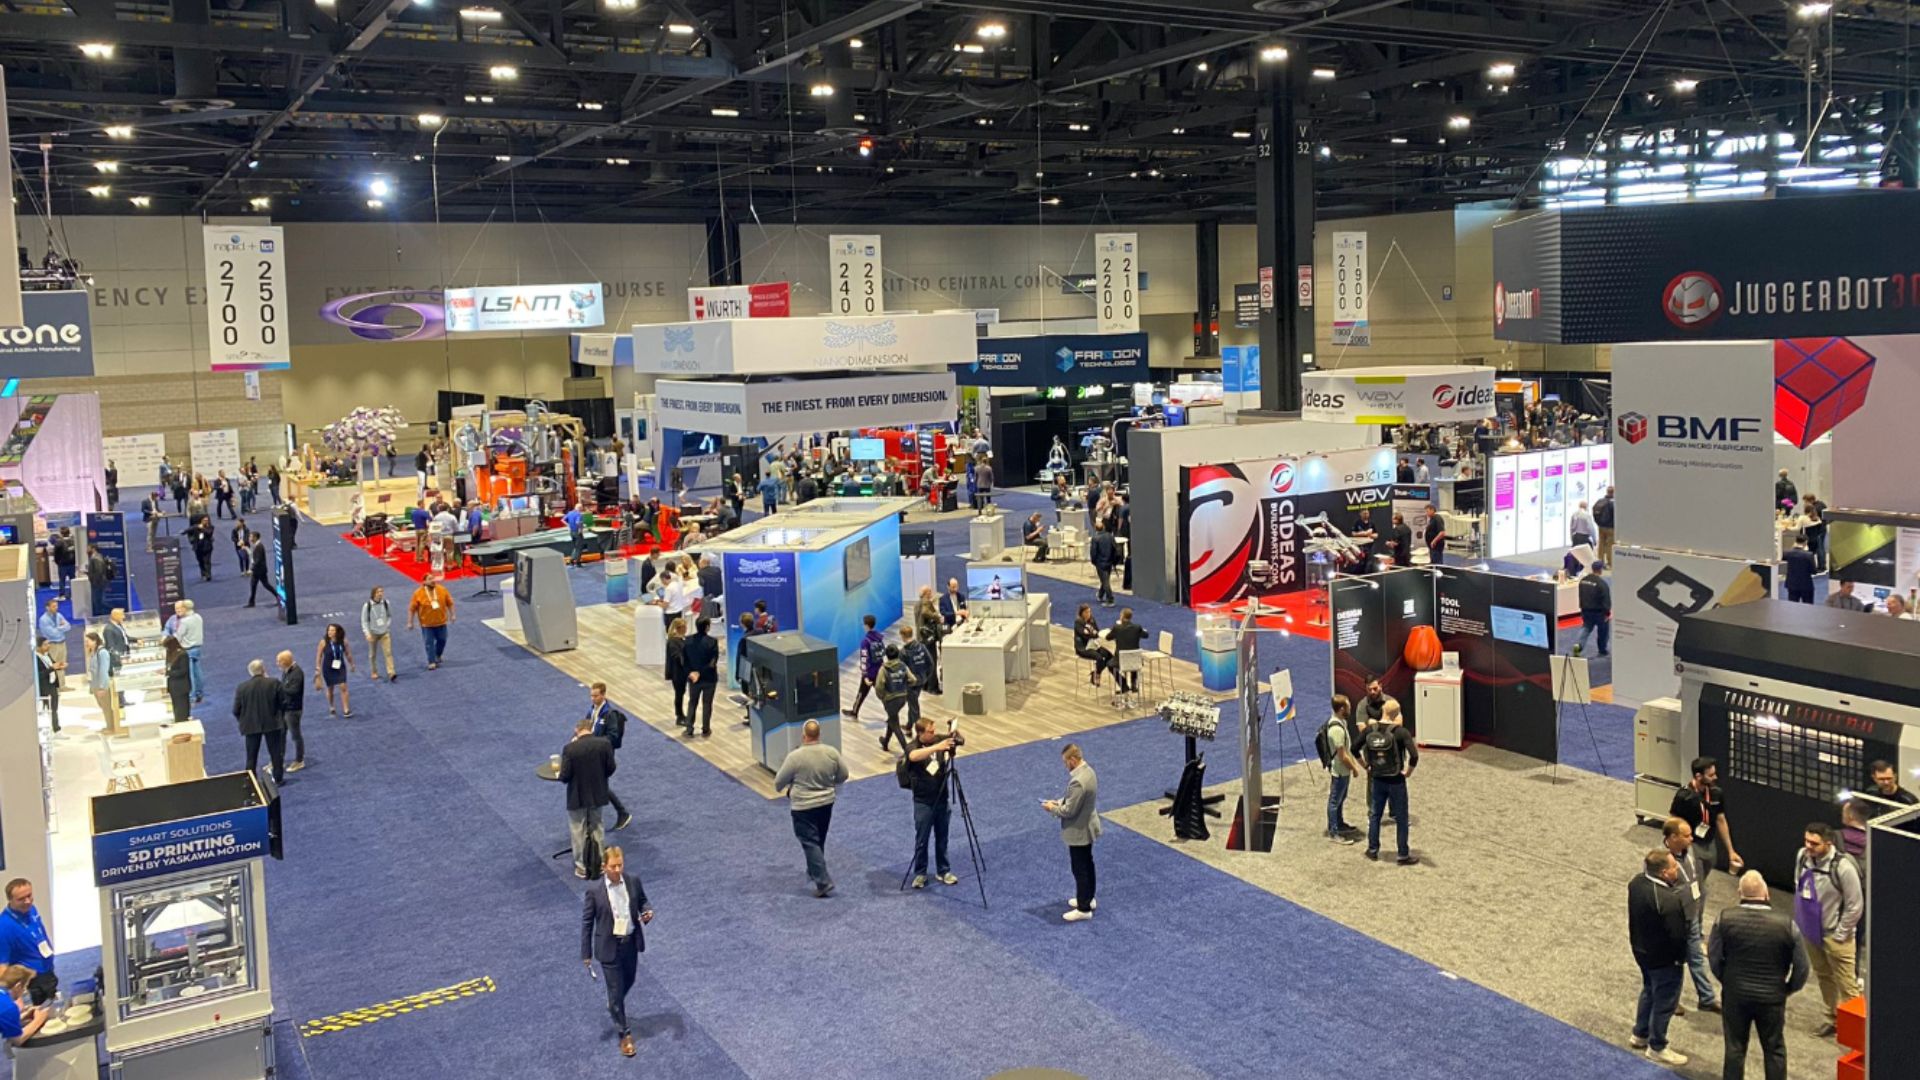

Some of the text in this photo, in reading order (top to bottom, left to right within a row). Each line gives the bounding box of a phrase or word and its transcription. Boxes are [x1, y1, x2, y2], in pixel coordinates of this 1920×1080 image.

[1260, 127, 1269, 141] V
[1300, 125, 1307, 138] V
[1258, 144, 1270, 158] 32
[1297, 141, 1310, 154] 32
[840, 262, 851, 316] 240
[864, 262, 875, 316] 230
[913, 277, 931, 292] TO
[939, 274, 1008, 291] CENTRAL
[762, 390, 949, 414] THE FINEST. FROM EVERY DIMENSION.
[1658, 415, 1762, 442] BMF
[1713, 443, 1763, 452] FABRICATION
[1279, 500, 1295, 585] CIDEAS
[1440, 597, 1461, 608] TOOL
[1440, 606, 1460, 617] PATH
[1724, 690, 1791, 717] TRADESMAN
[129, 820, 233, 846] SMART SOLUTIONS
[101, 840, 262, 878] DRIVEN BY YASKAWA MOTION
[127, 833, 236, 864] 3D PRINTING
